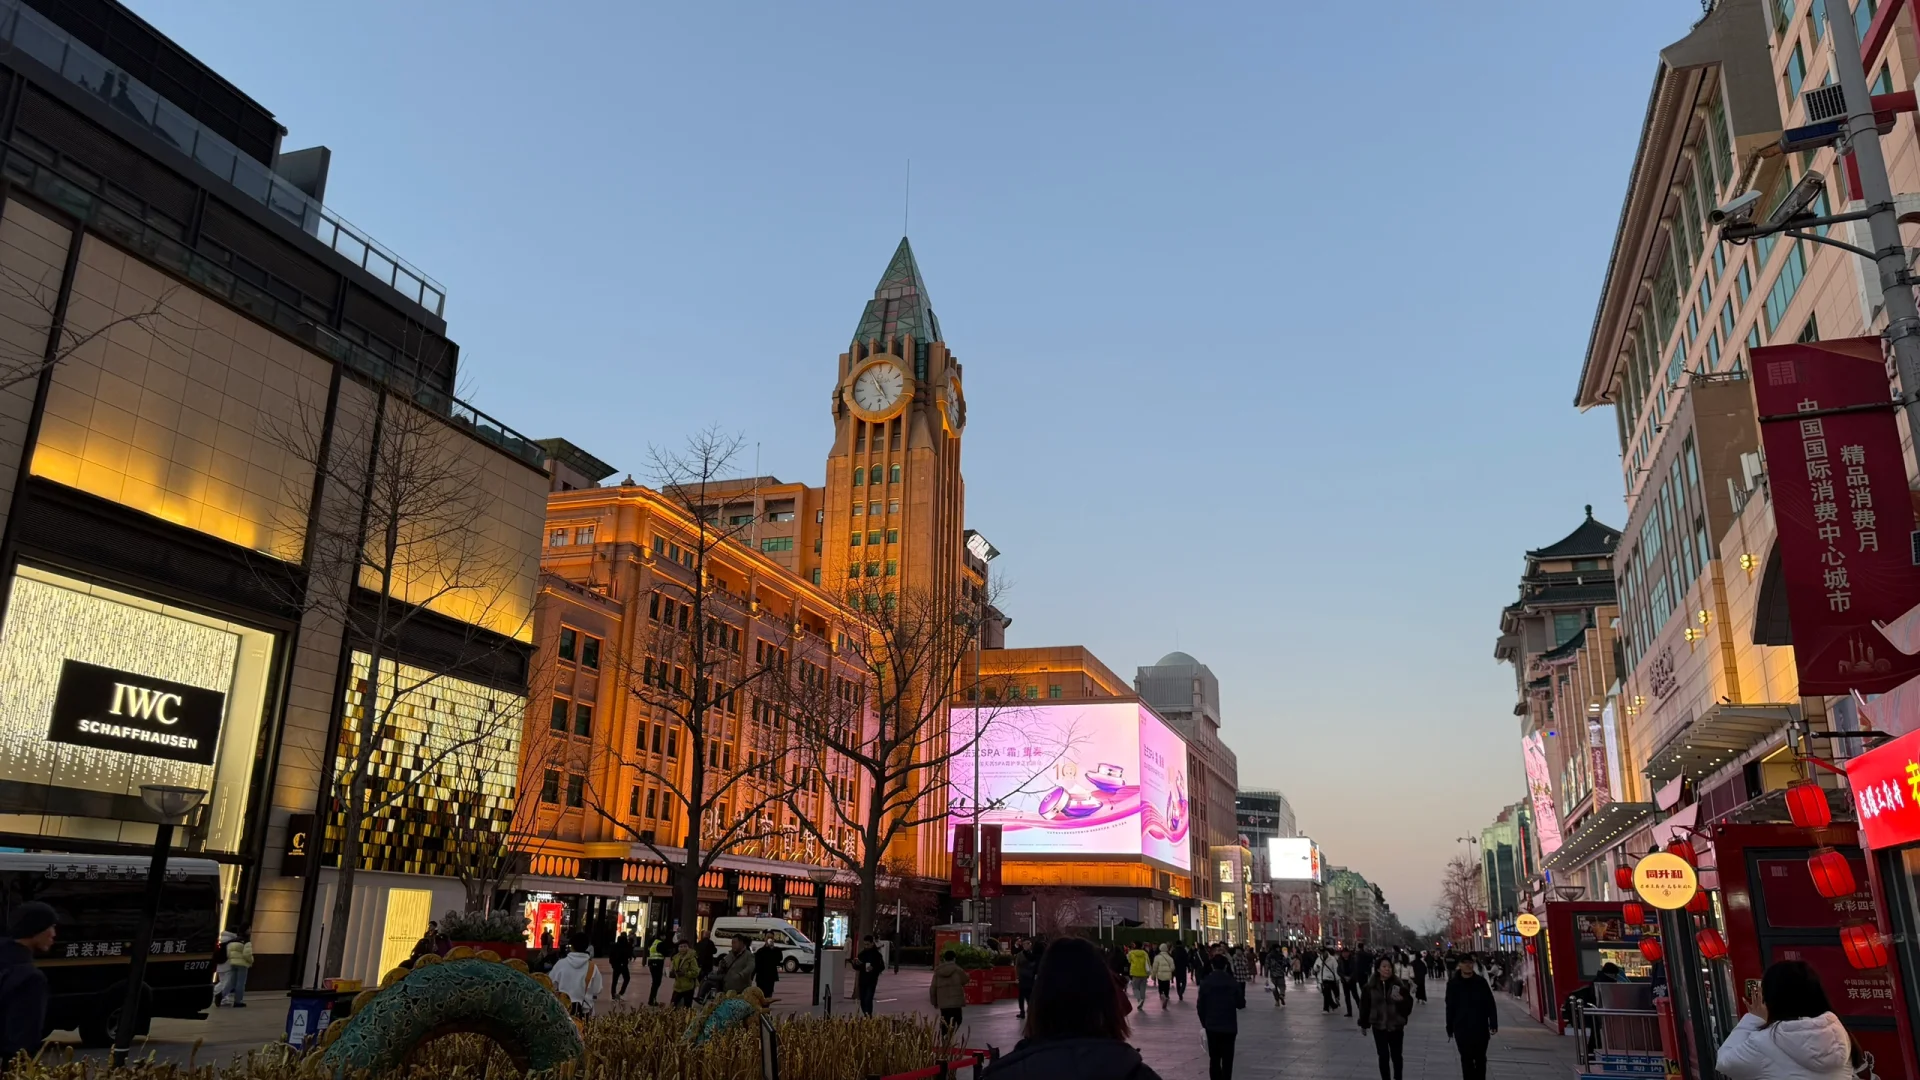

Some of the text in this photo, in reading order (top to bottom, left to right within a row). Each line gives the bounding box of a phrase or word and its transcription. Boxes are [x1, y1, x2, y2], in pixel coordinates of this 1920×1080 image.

[1797, 398, 1852, 613] 中国国际消费中心城市
[1840, 444, 1879, 553] 精品消费月
[109, 682, 182, 725] IWC
[77, 719, 198, 749] SCHAFFHAUSEN
[1646, 869, 1683, 879] 同升和
[65, 942, 122, 957] 武装押运
[184, 961, 210, 970] E2707
